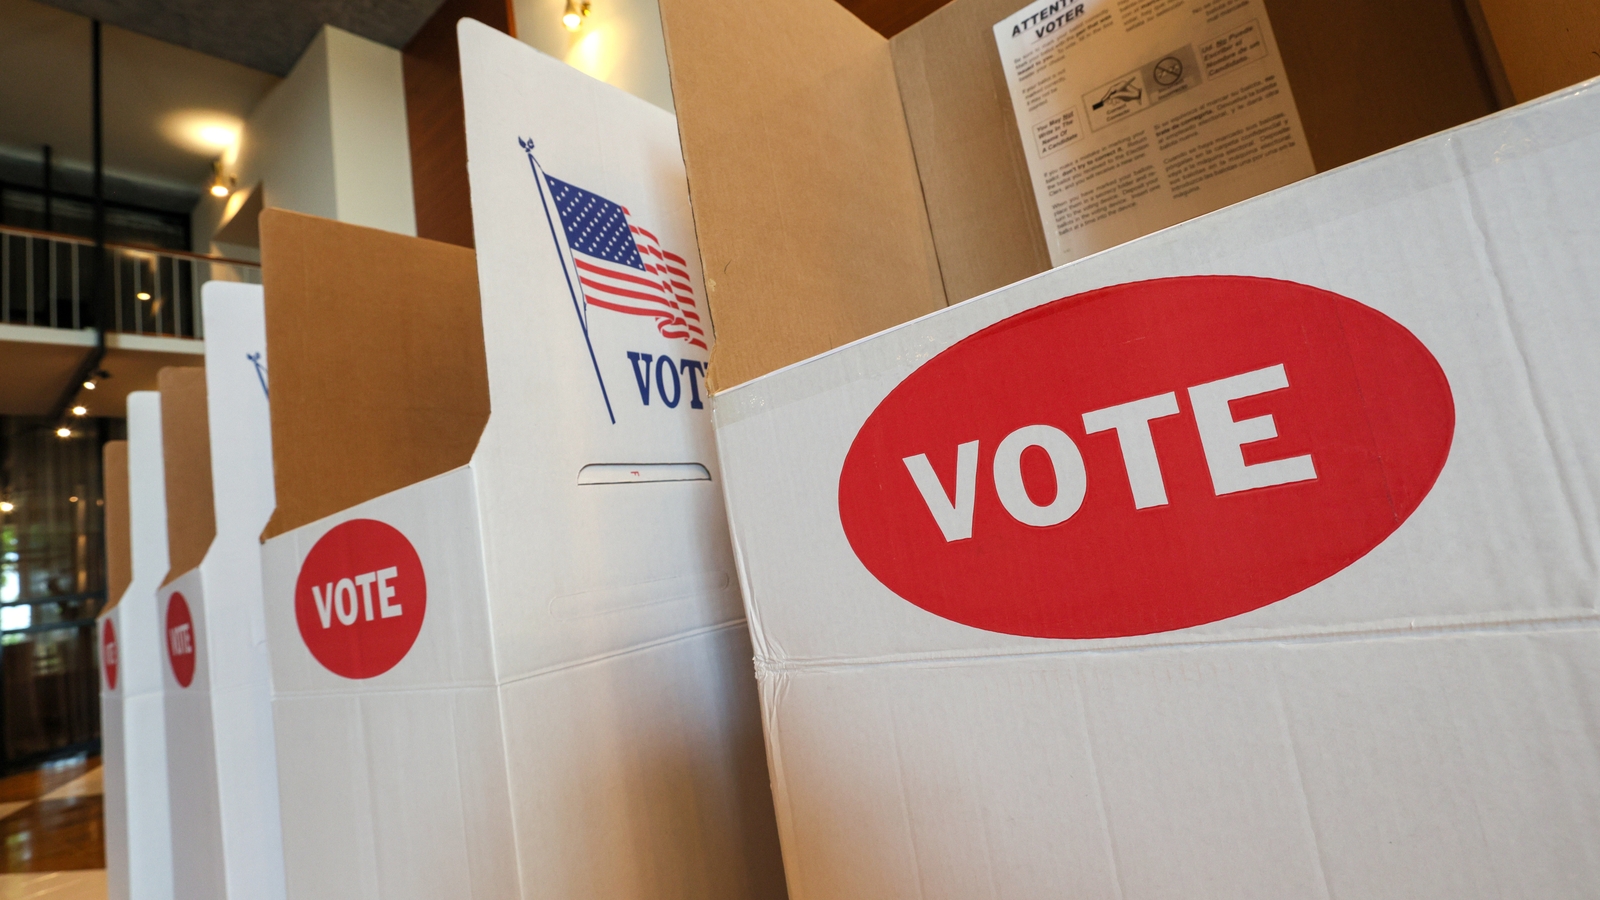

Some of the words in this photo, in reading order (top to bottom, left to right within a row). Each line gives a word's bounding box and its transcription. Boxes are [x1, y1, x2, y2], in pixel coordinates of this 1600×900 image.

[1036, 4, 1084, 38] VOTER
[626, 351, 708, 409] VOT
[903, 364, 1318, 542] VOTE
[312, 566, 402, 629] VOTE
[169, 623, 192, 656] VOTE
